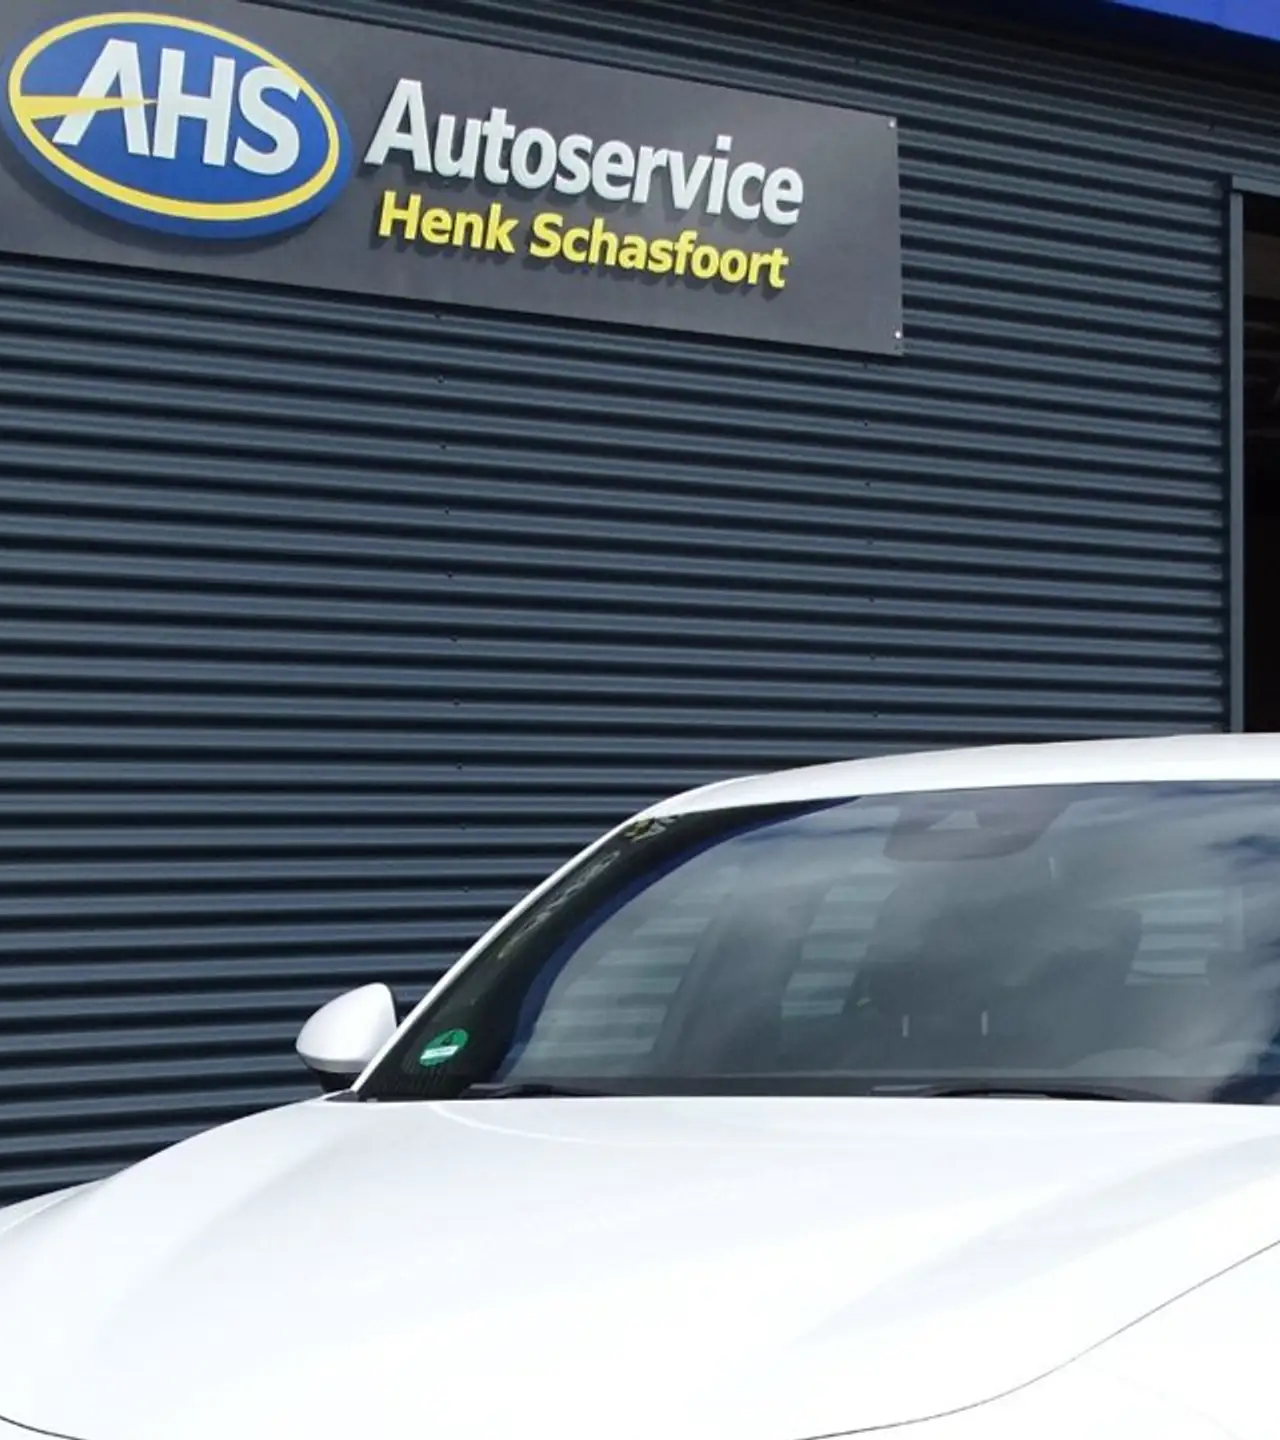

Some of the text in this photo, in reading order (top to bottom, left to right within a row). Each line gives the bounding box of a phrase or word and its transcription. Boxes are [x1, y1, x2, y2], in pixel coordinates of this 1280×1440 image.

[52, 38, 308, 176] AHS
[364, 76, 805, 226] Autoservice
[378, 191, 790, 290] Henk Schasfoort
